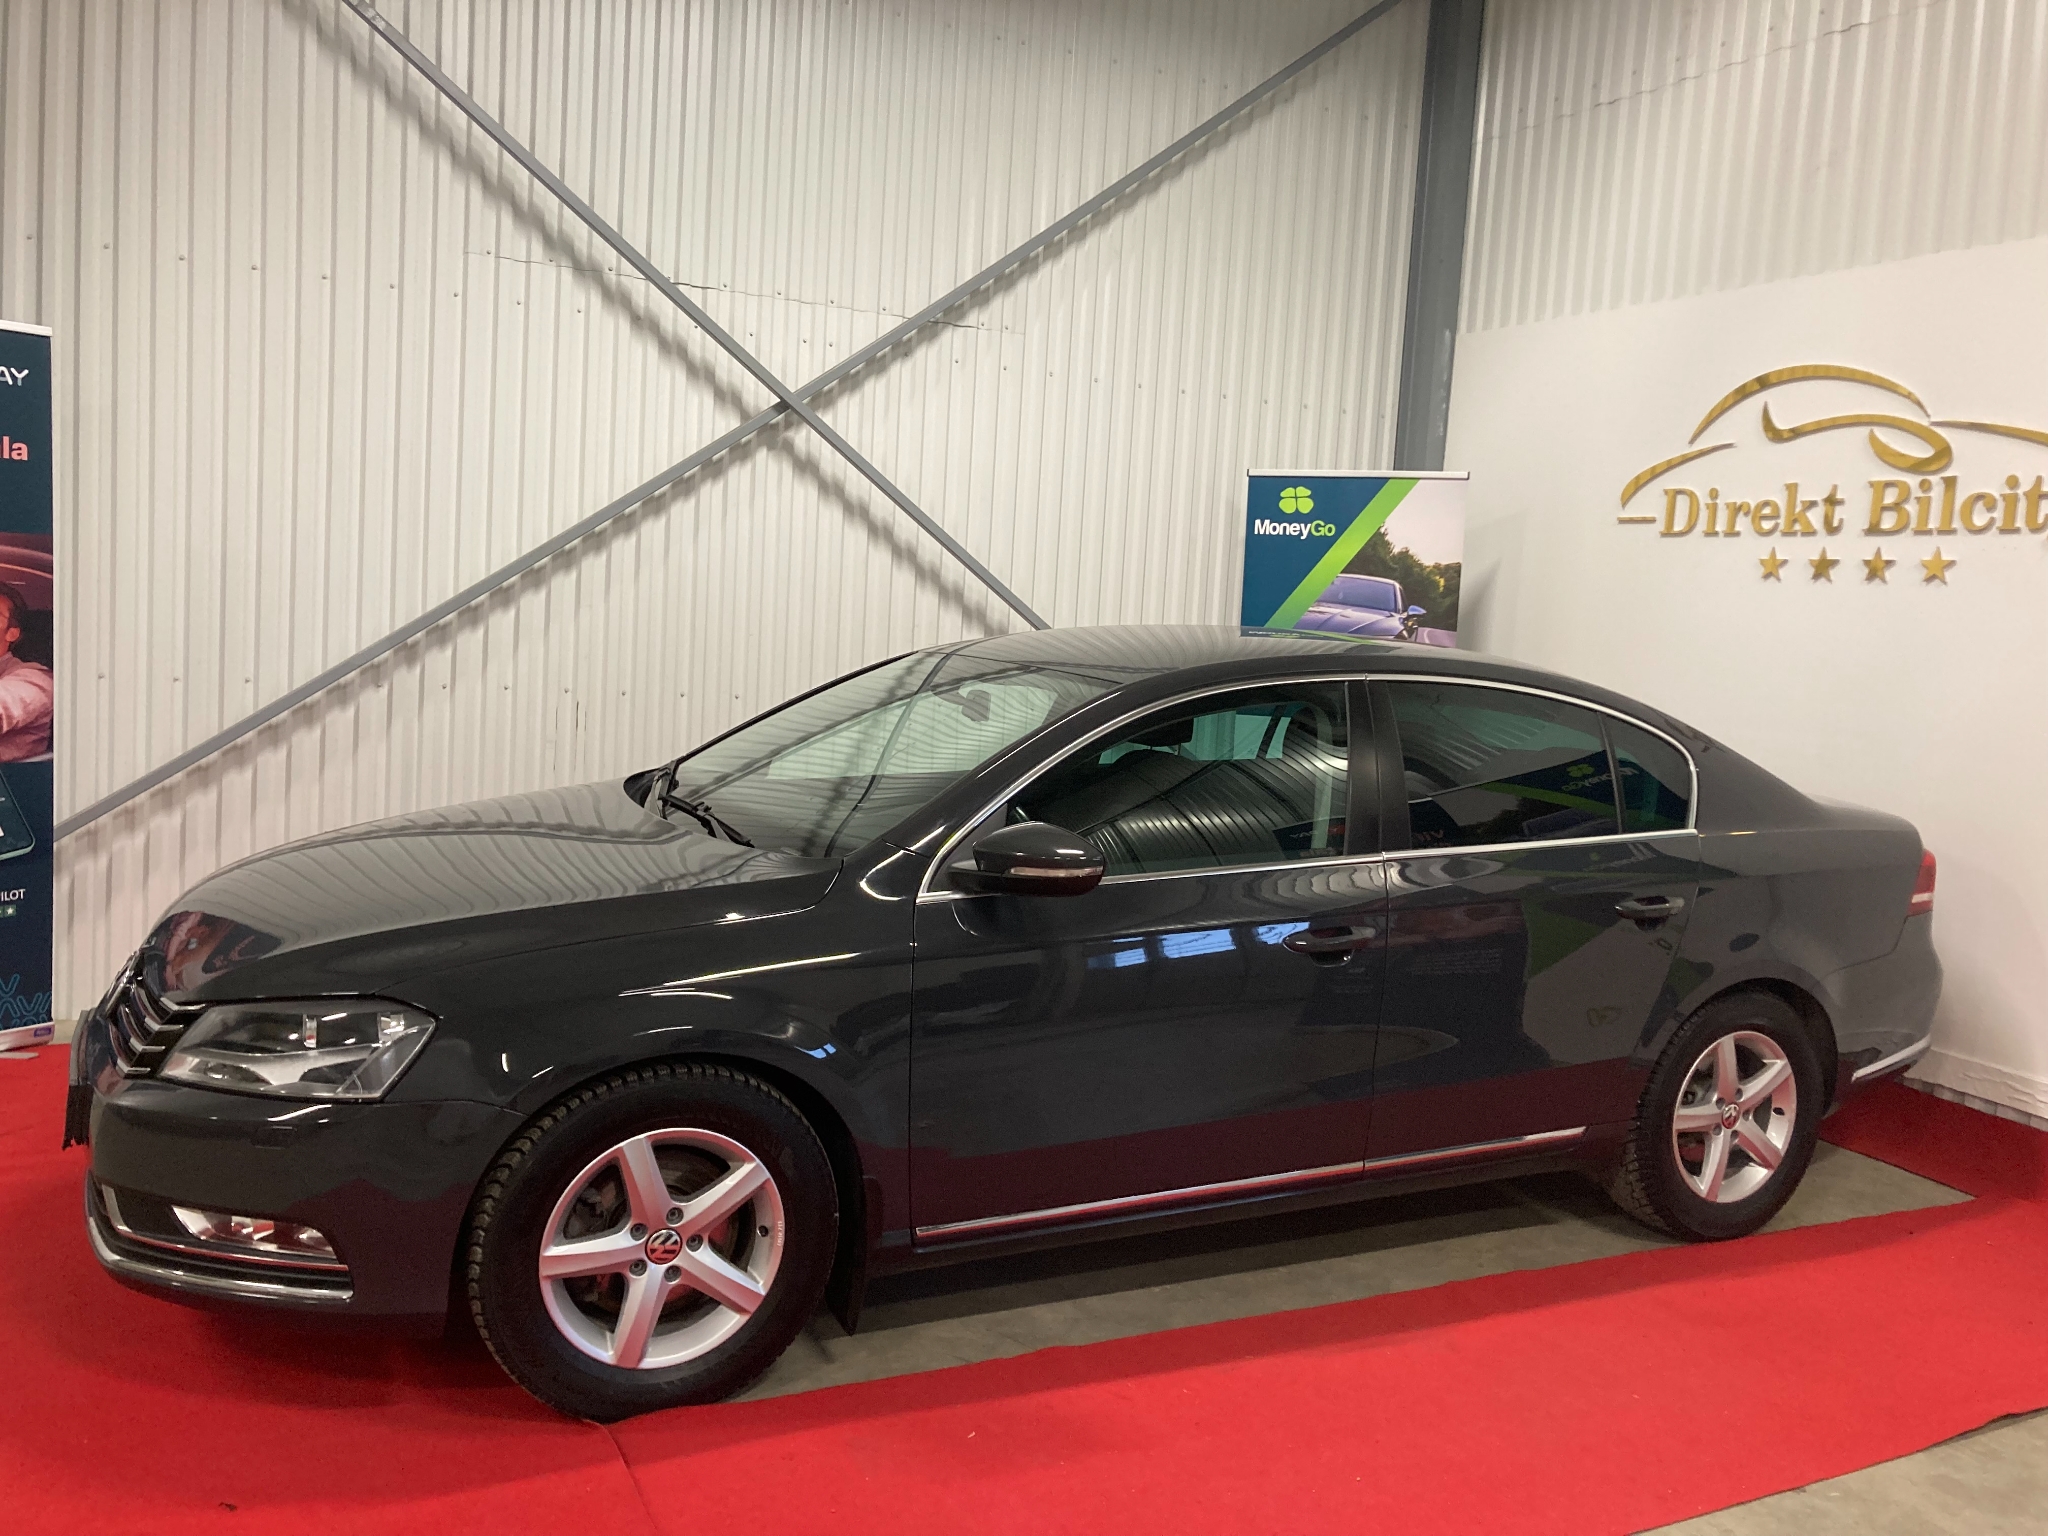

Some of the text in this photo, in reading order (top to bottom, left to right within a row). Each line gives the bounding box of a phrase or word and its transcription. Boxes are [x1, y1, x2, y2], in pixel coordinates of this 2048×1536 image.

[0, 436, 28, 461] la
[1659, 474, 2048, 537] Direkt Bilcit
[1254, 519, 1336, 539] MoneyGo
